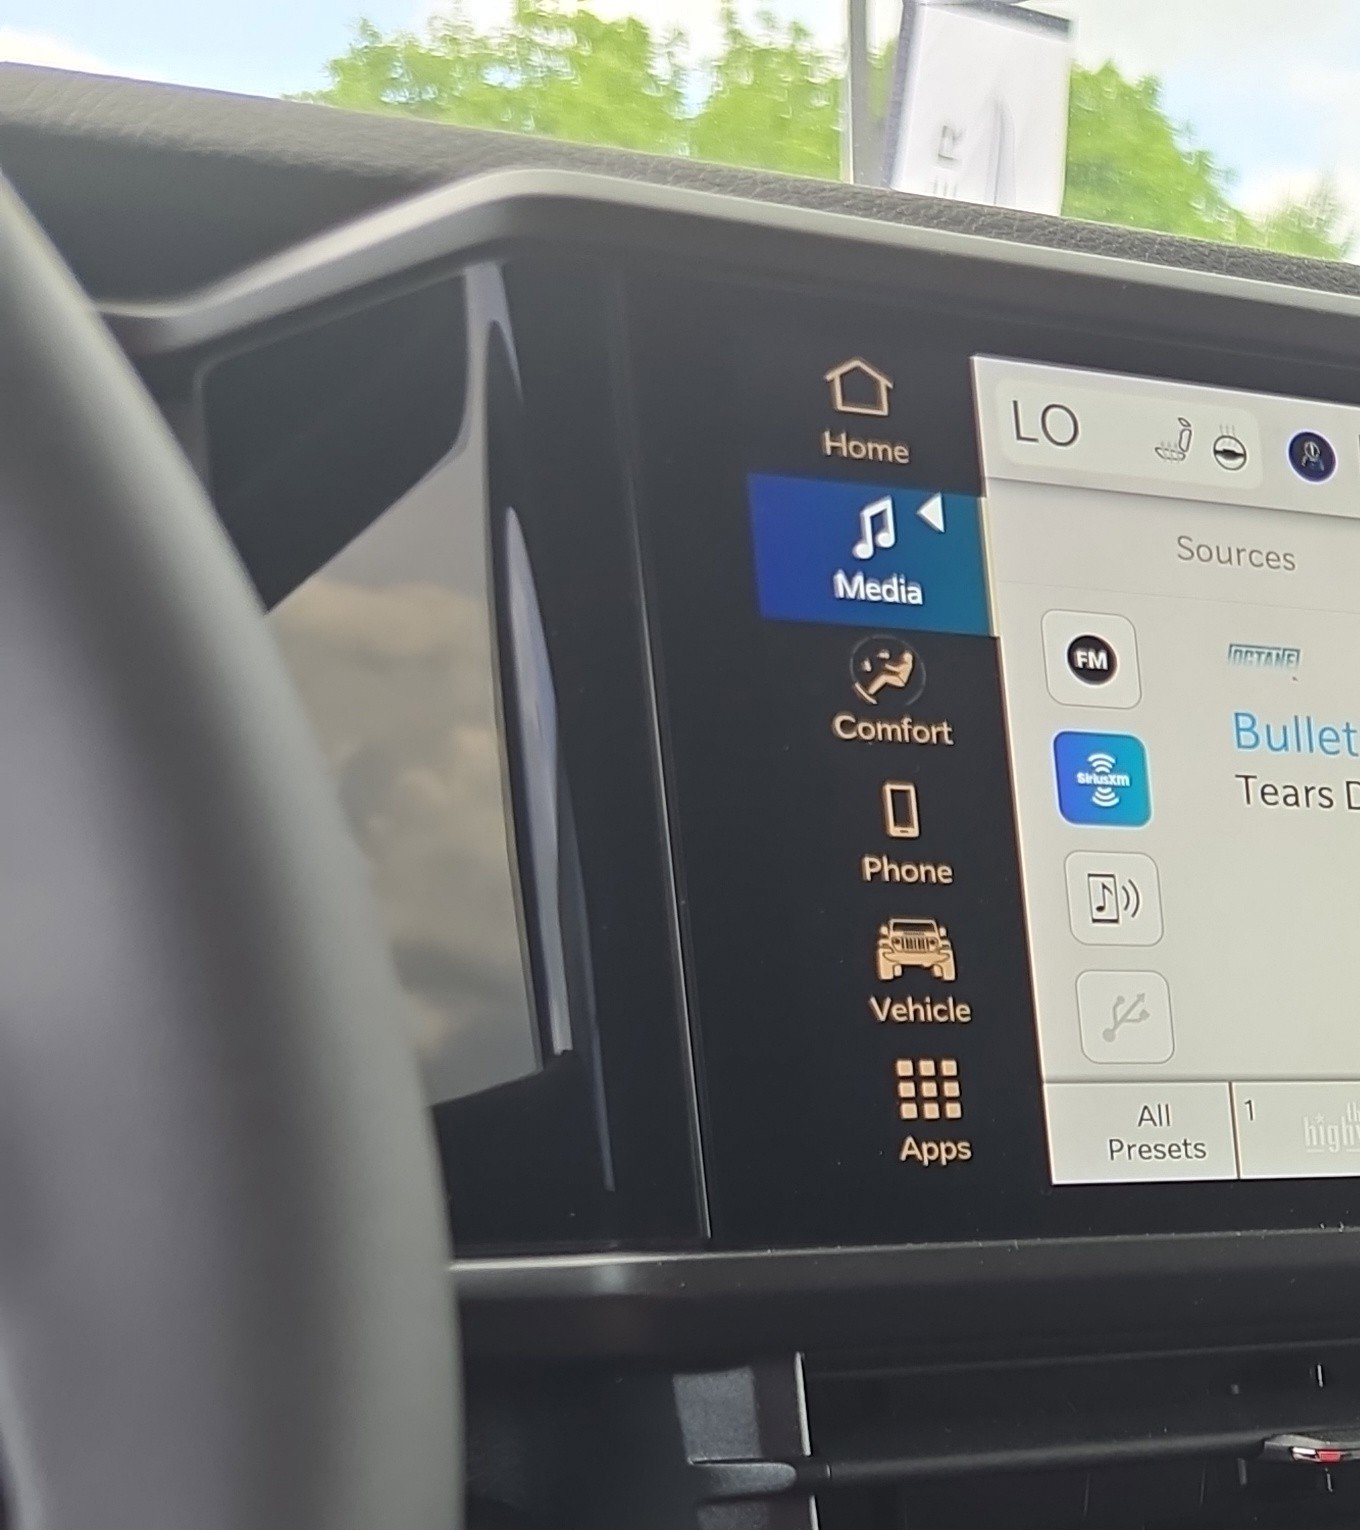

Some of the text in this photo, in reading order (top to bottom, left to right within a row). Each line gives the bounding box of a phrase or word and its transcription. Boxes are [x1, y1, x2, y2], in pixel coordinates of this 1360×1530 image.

[1012, 399, 1081, 449] LO
[823, 428, 911, 464] Home
[1177, 534, 1297, 573] Sources
[833, 569, 924, 606] Media
[1075, 649, 1109, 671] FM
[833, 713, 954, 747] Comfort
[1233, 711, 1359, 757] Bullet
[1234, 773, 1334, 811] Tears
[861, 855, 955, 885] Phone
[869, 995, 972, 1024] Vehicle
[1137, 1105, 1172, 1127] All
[1244, 1100, 1256, 1121] 1
[900, 1135, 973, 1166] Apps
[1107, 1138, 1207, 1162] Presets
